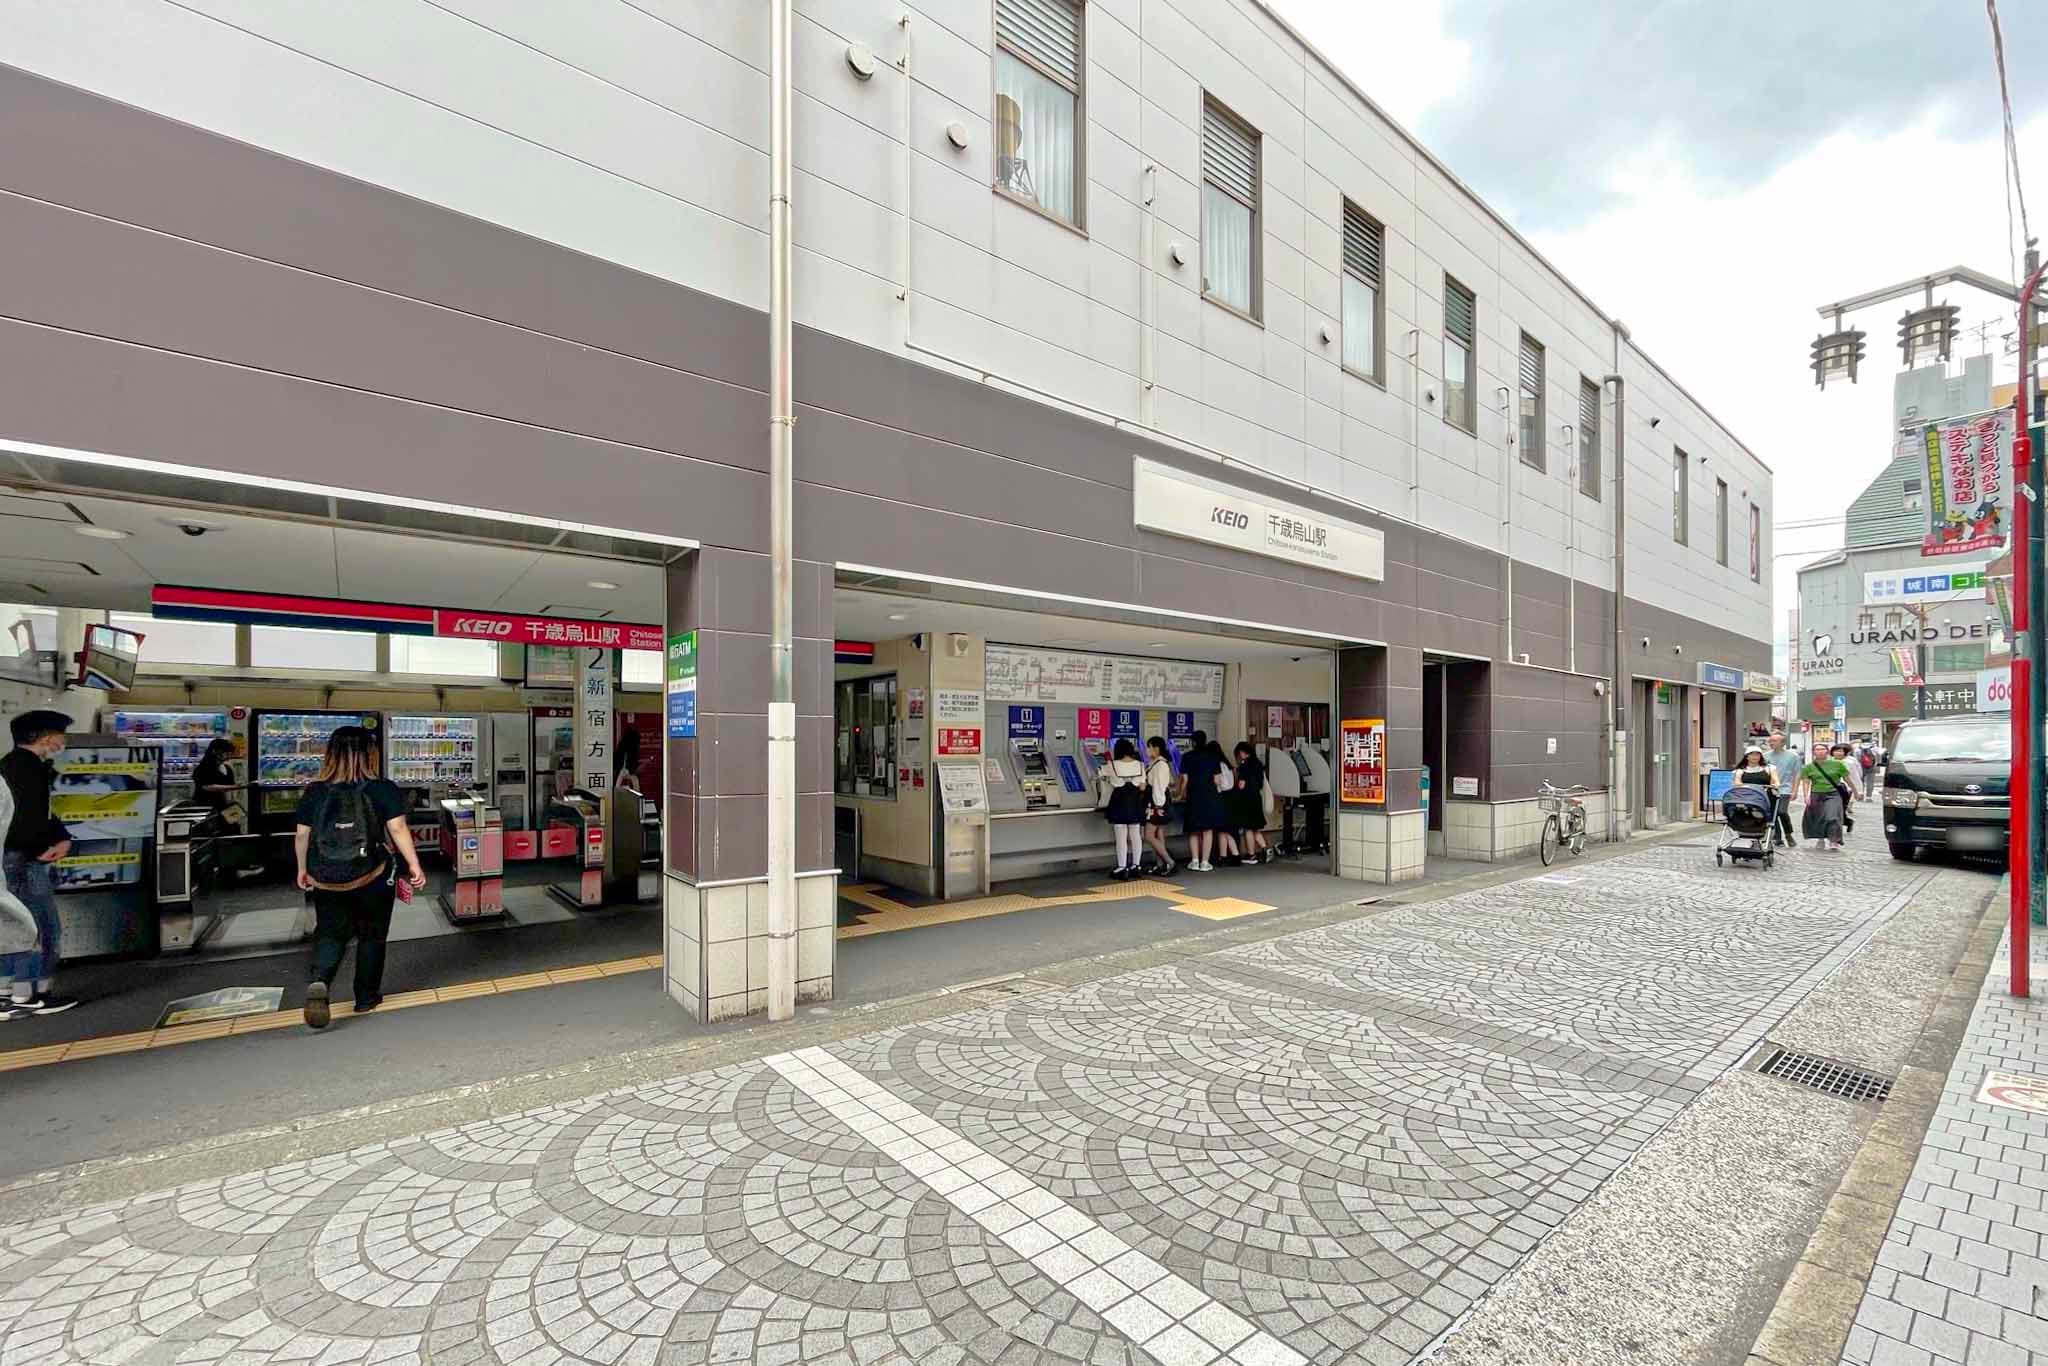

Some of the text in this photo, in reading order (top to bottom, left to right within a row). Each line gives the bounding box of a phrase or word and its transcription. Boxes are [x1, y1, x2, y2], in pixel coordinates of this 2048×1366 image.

[1948, 425, 1975, 504] ステキなお店
[1210, 506, 1249, 530] KEIO
[1268, 514, 1327, 547] 千歳烏山駅
[453, 618, 513, 636] KEIO
[524, 621, 620, 645] 千歳烏山駅
[1850, 627, 1938, 645] URANO
[1802, 658, 1844, 671] URANO
[587, 679, 607, 789] 新宿方面
